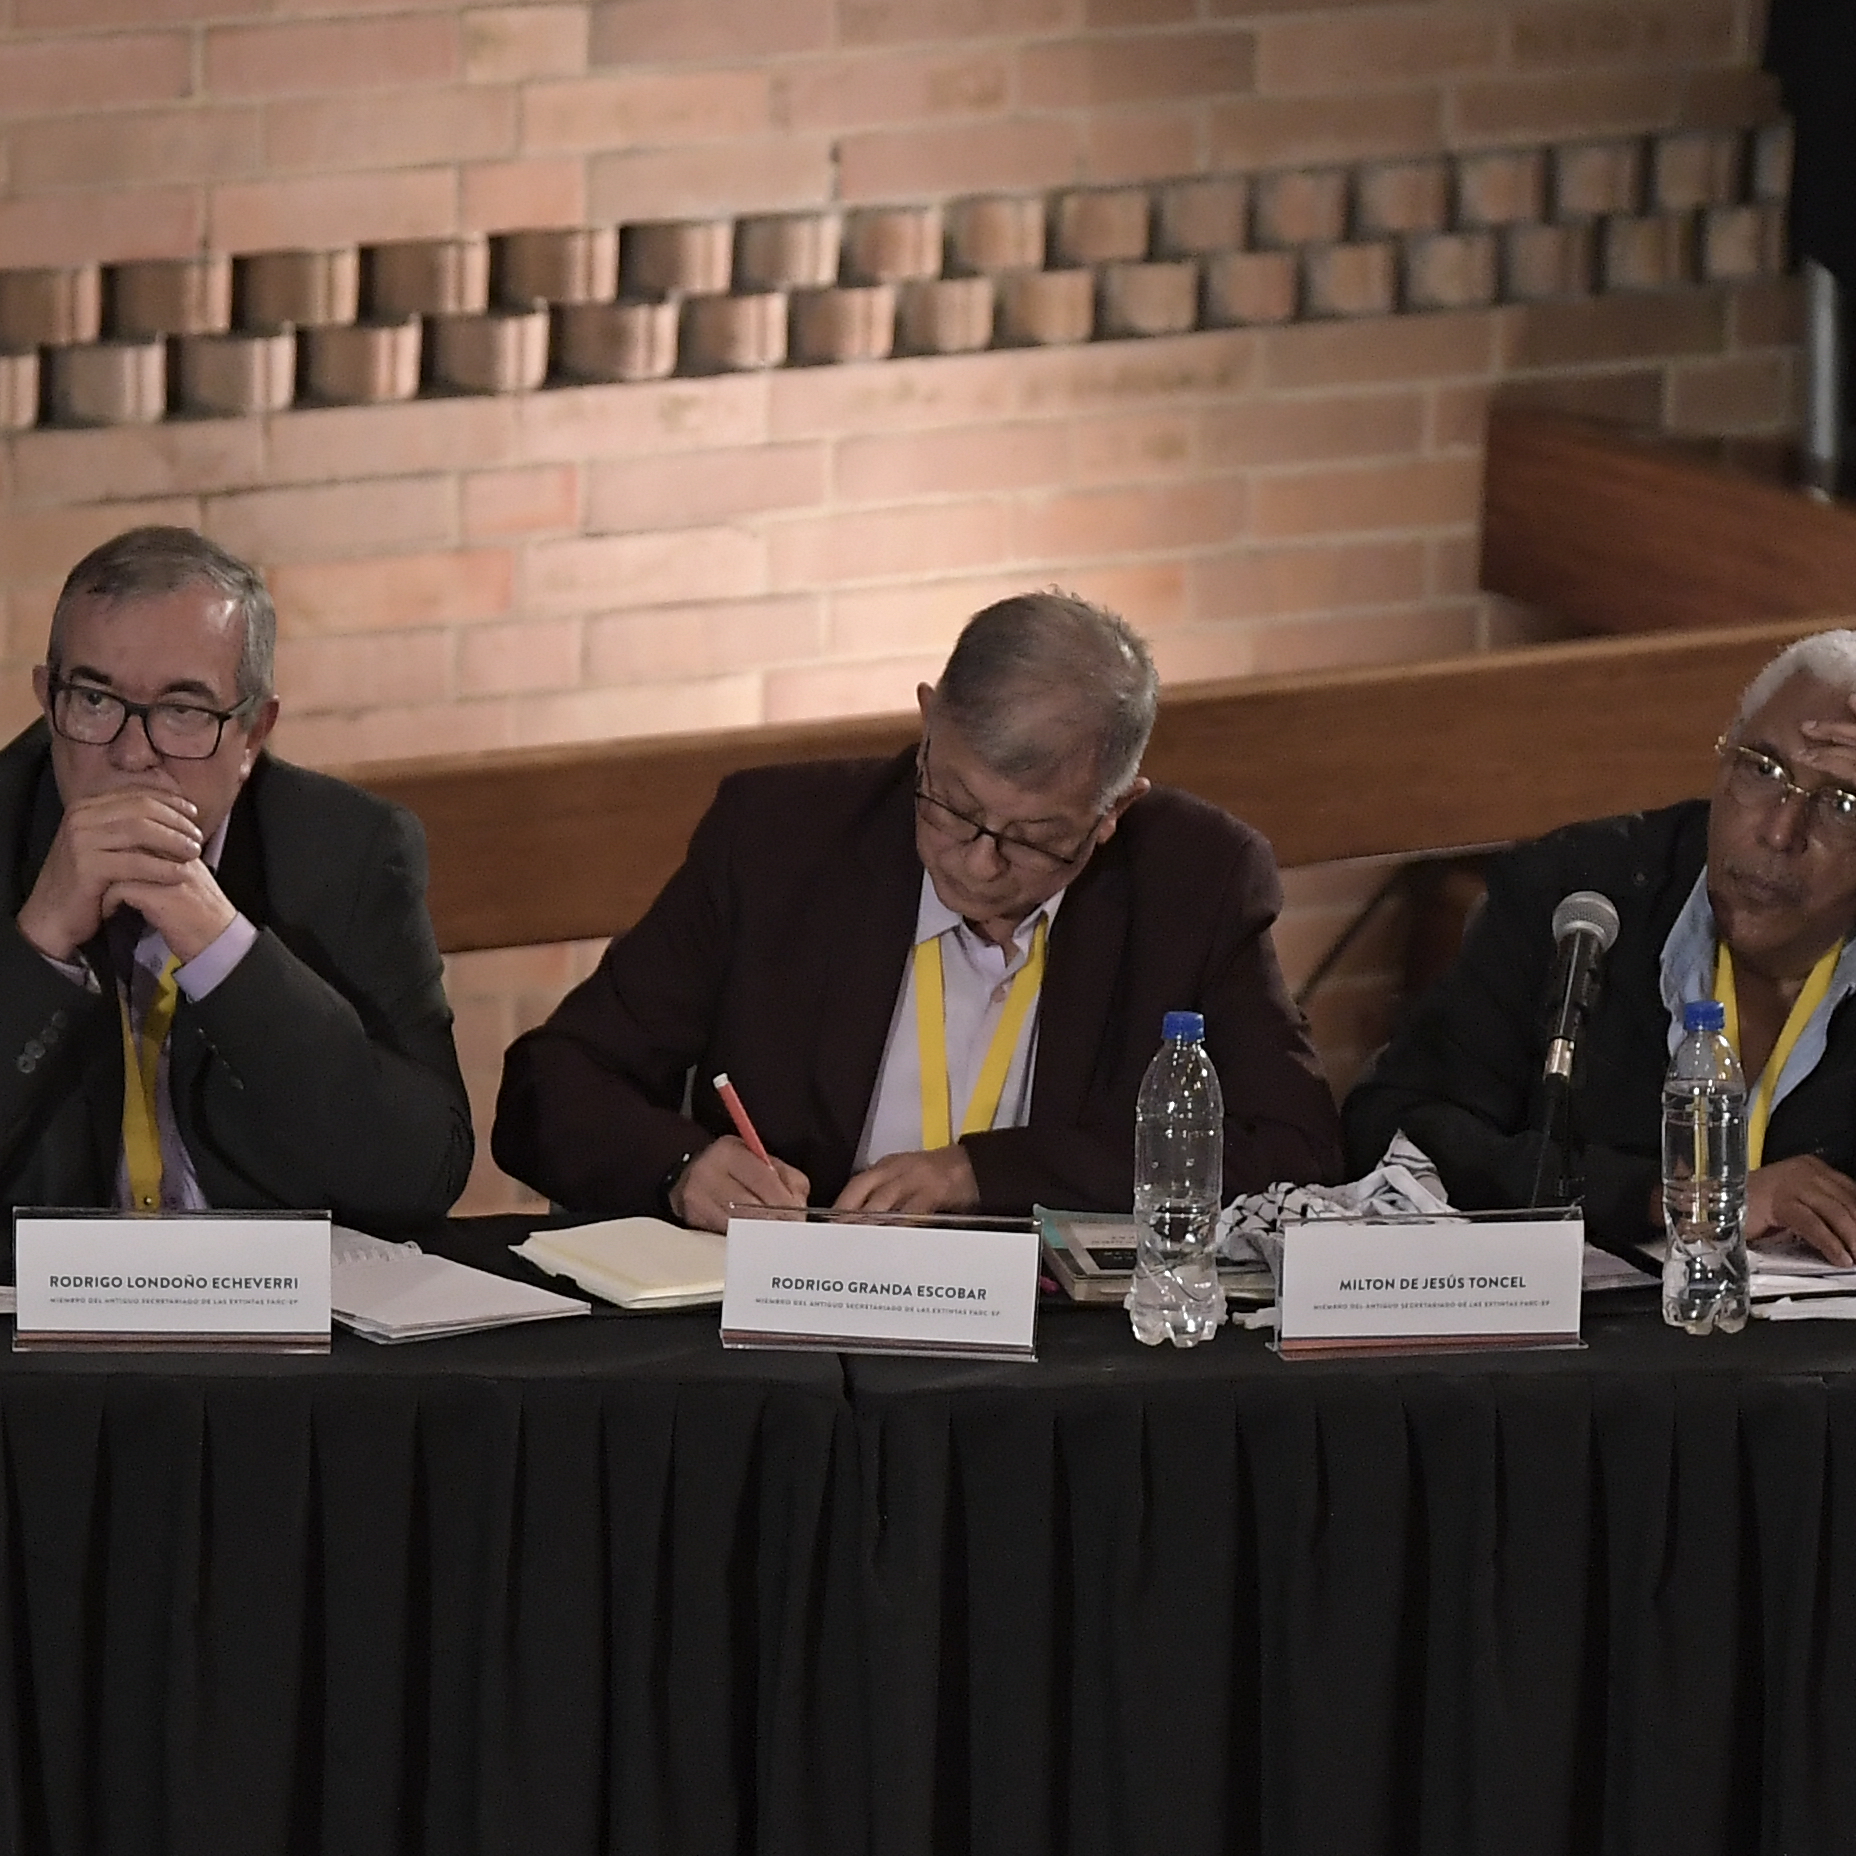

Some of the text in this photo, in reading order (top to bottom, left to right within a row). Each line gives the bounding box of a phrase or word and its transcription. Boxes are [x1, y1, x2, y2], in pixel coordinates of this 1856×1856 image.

[49, 1274, 298, 1290] RODRIGO LONDOÑO ECHEVERRI
[771, 1276, 987, 1301] RODRIGO GRANDA ESCOBAR
[1339, 1274, 1527, 1291] MILTON DE JESÚS TONCEL
